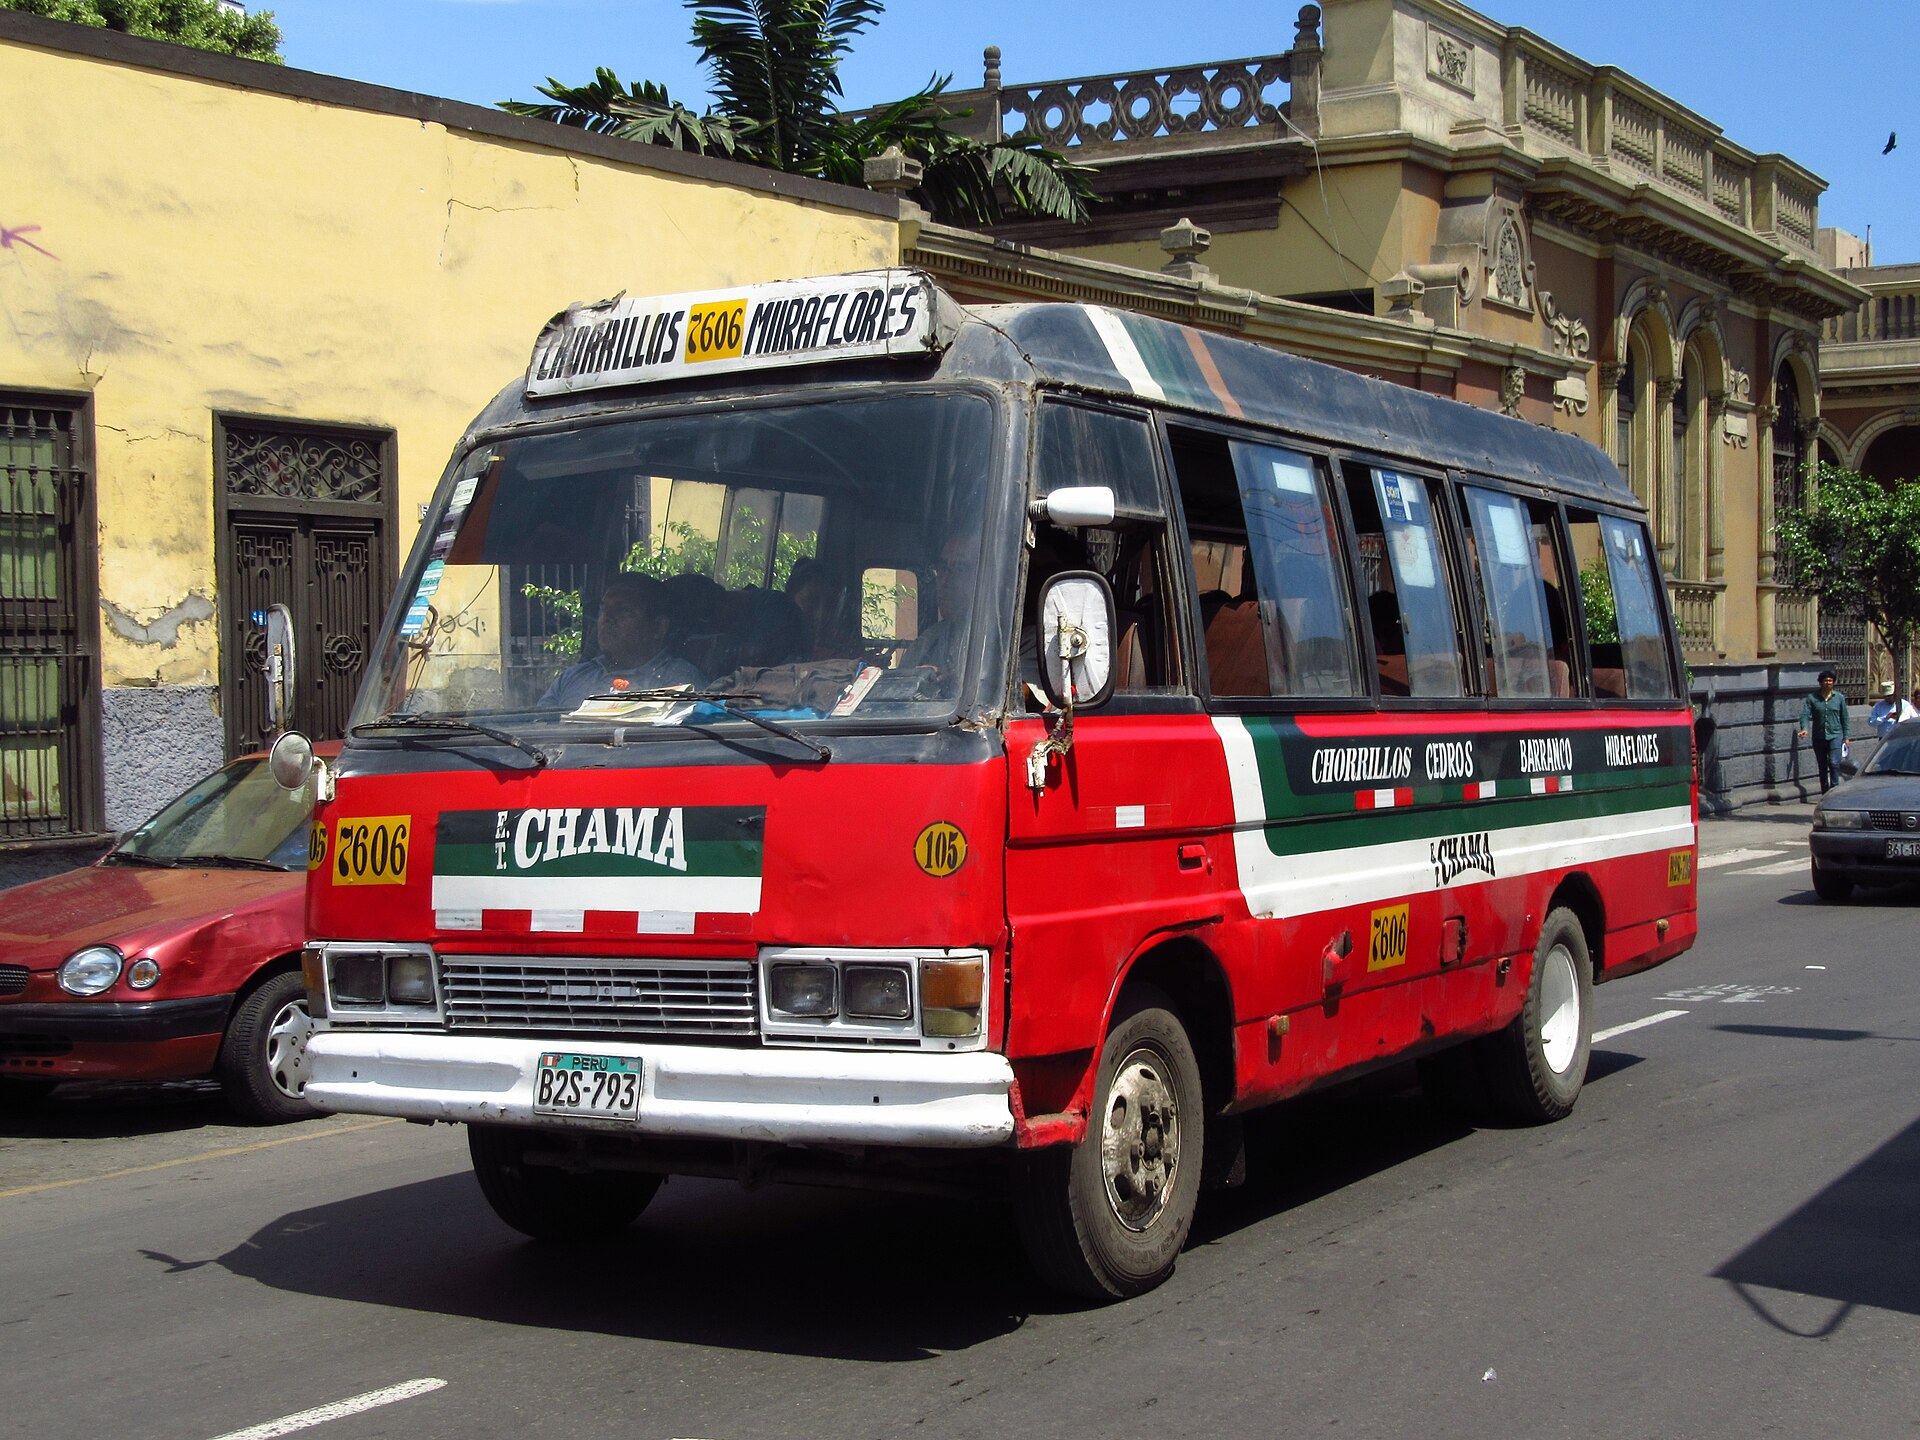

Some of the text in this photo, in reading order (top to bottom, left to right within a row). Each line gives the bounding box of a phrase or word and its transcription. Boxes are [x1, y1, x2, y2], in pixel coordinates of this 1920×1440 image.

[688, 307, 743, 354] 7606
[1311, 733, 1659, 784] CHORRILLOS CEDROS BARRANCO MIRAFLORES
[338, 824, 407, 877] 7606
[514, 807, 688, 872] CHAMA
[924, 830, 959, 870] 105
[1437, 832, 1496, 886] CHAMA
[1372, 911, 1407, 962] 7606
[572, 1056, 609, 1071] PERU
[538, 1068, 637, 1111] B2S-793
